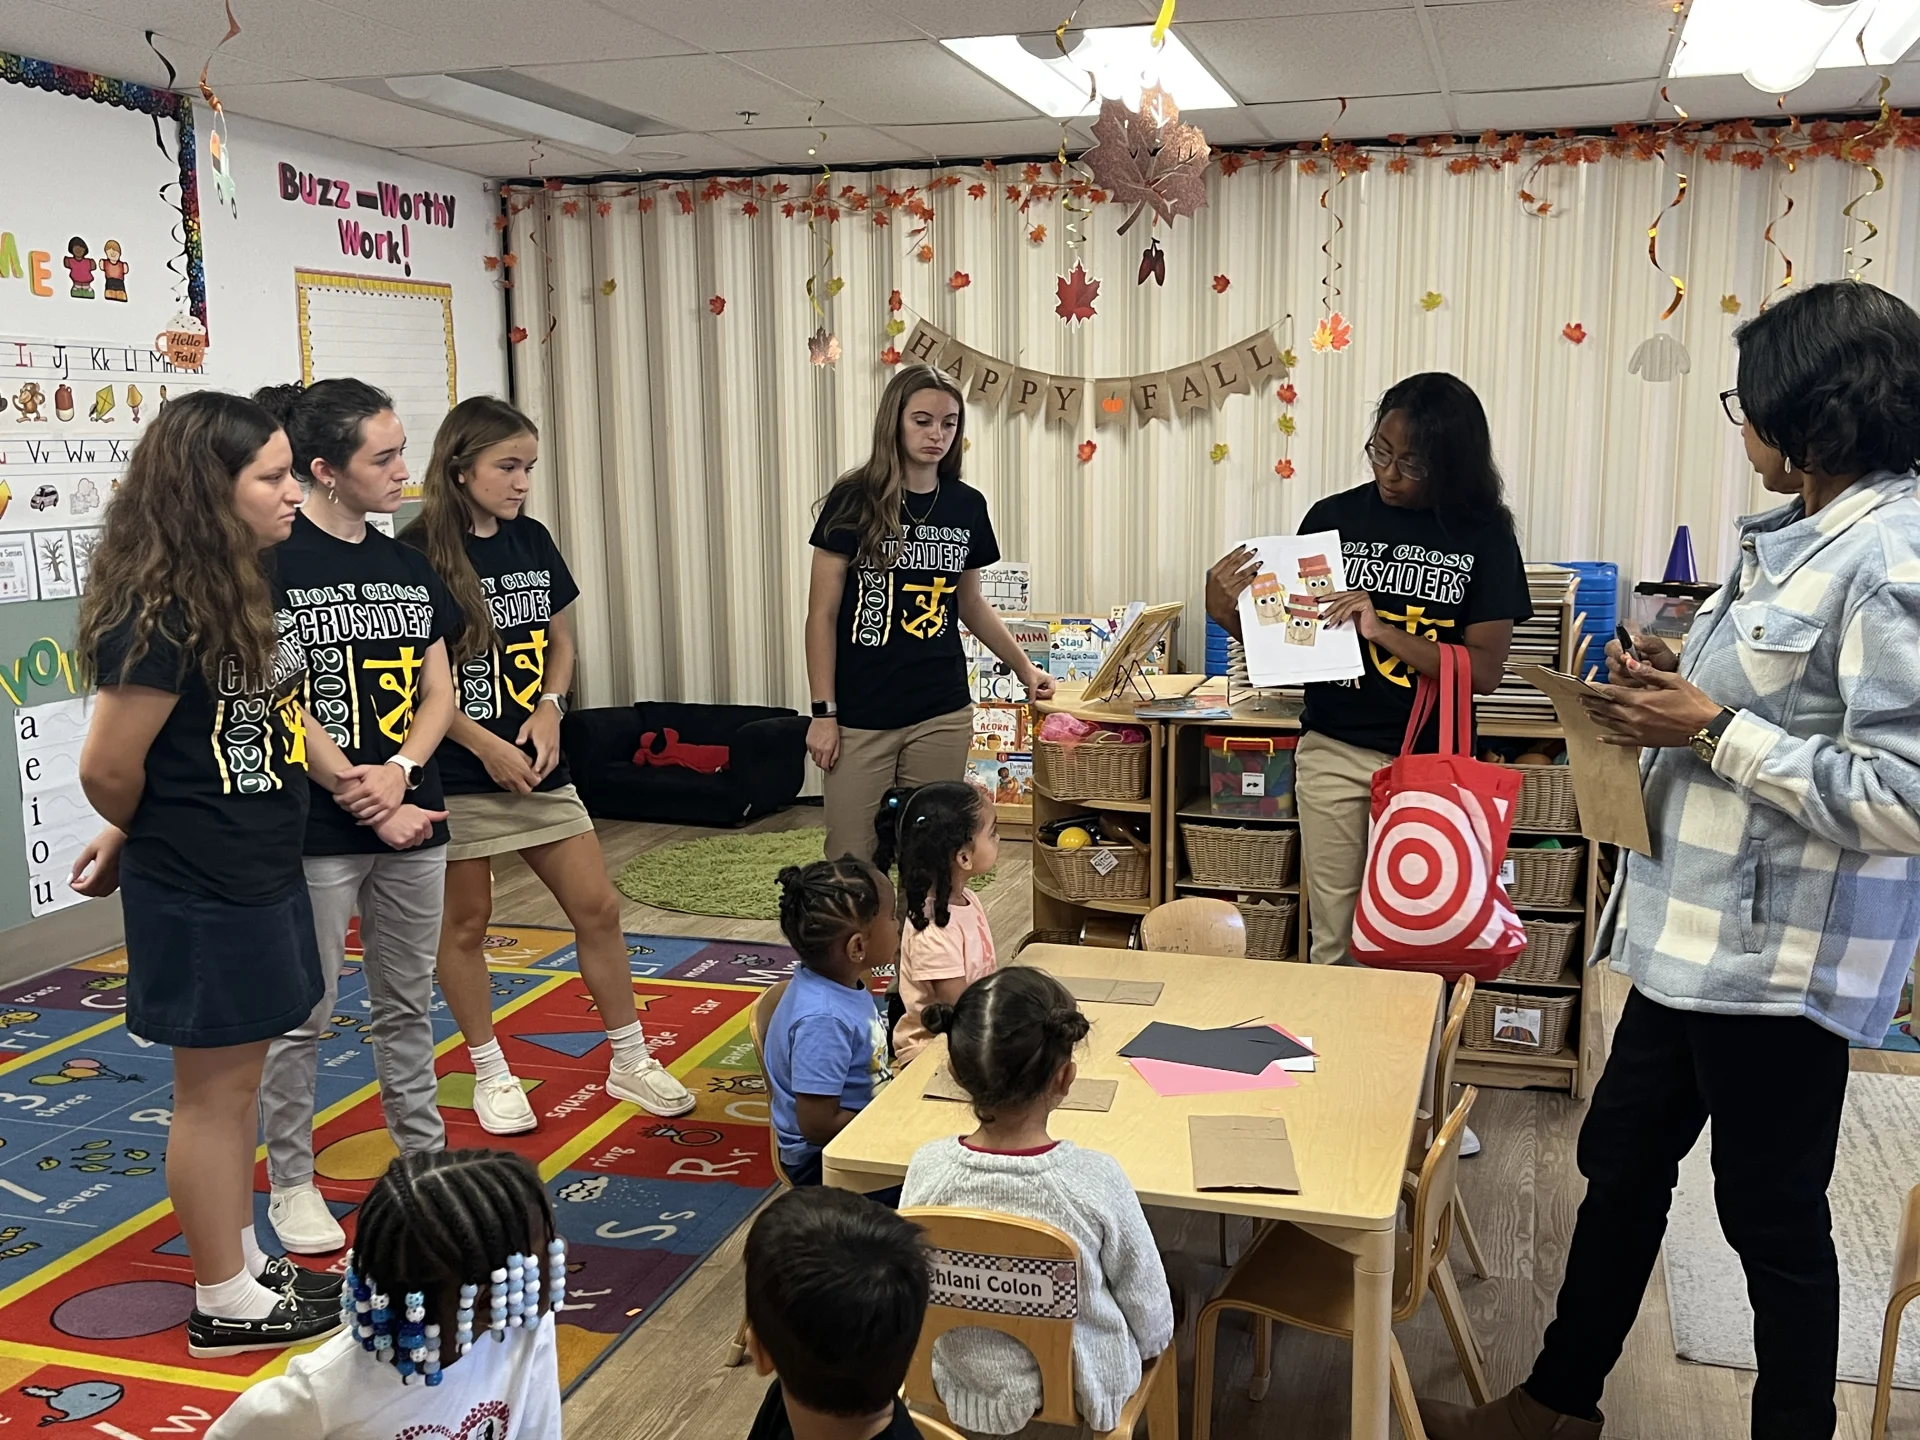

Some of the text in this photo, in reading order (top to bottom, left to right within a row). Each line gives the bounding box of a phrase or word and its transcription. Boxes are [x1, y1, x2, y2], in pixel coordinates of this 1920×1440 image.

[337, 218, 412, 277] Work!
[170, 333, 201, 347] Hello
[53, 345, 69, 380] Jj
[90, 347, 110, 371] Kk
[173, 351, 198, 364] Fall
[909, 330, 1274, 412] HAPPY FALL
[26, 440, 50, 464] Vv
[64, 440, 95, 463] Ww
[109, 439, 130, 462] Xx
[915, 525, 971, 544] CROSS
[1341, 541, 1474, 572] OLY CROSS
[287, 582, 430, 607] HOLY CROSS
[858, 571, 886, 647] 2026
[294, 604, 434, 646] CRUSADERS
[1015, 632, 1048, 644] MIMI
[1060, 637, 1083, 648] Stay
[462, 648, 493, 720] 026
[20, 715, 39, 740] a
[980, 722, 1009, 732] ACORN
[225, 698, 272, 794] 2026
[25, 757, 41, 782] e
[31, 796, 42, 827] i
[31, 840, 49, 865] o
[34, 878, 54, 906] u
[682, 959, 720, 979] mouse
[15, 986, 61, 1003] grass
[691, 998, 722, 1015] star
[324, 1048, 361, 1068] nine
[35, 1093, 92, 1118] three
[546, 1082, 604, 1119] square
[590, 1146, 636, 1168] ring
[666, 1148, 759, 1175] Rr
[45, 1182, 112, 1215] seven
[595, 1210, 696, 1241] Ss
[928, 1269, 1042, 1297] ehlani Colon
